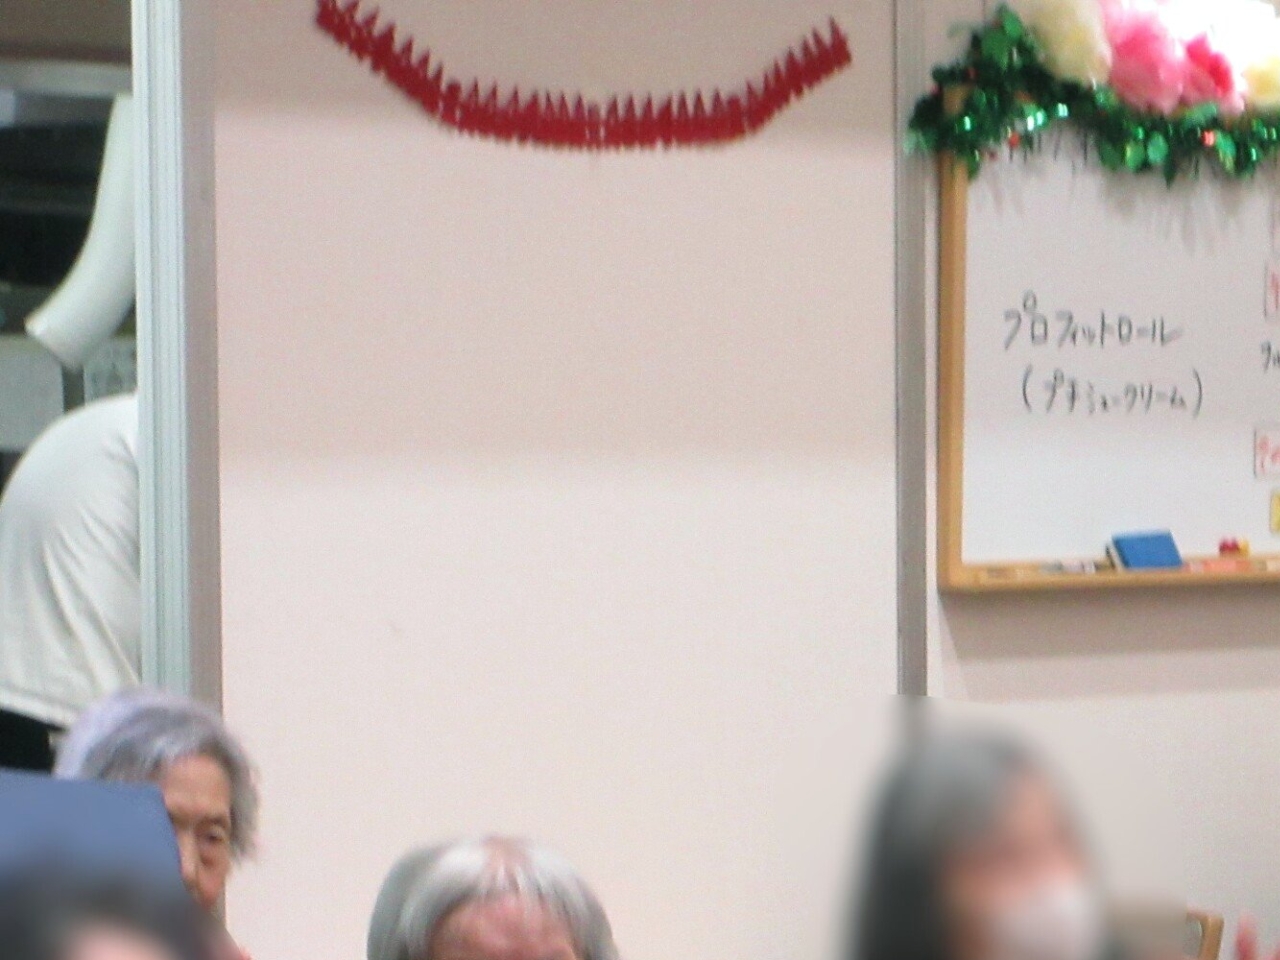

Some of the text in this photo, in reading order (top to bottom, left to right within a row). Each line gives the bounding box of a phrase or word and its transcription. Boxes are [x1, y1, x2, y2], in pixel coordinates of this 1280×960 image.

[1004, 289, 1184, 350] プロフィットロール
